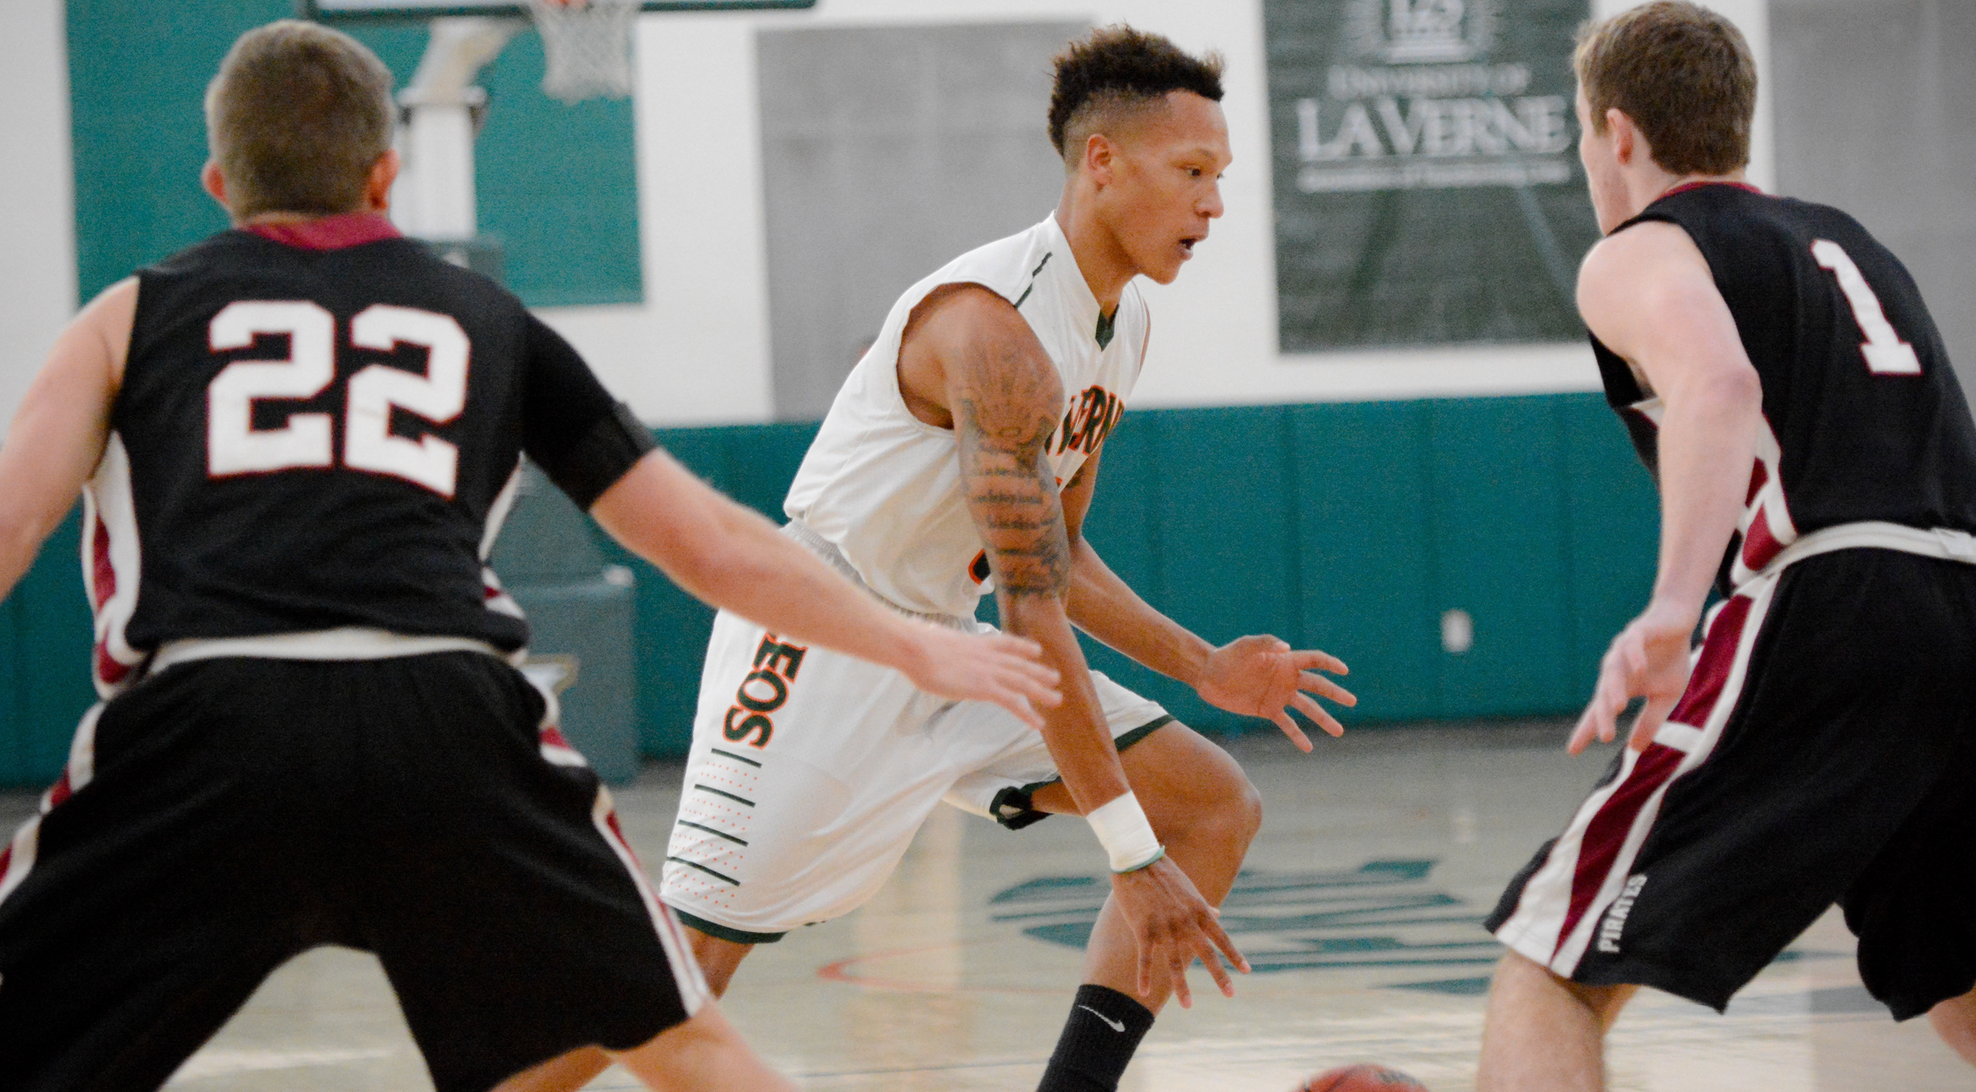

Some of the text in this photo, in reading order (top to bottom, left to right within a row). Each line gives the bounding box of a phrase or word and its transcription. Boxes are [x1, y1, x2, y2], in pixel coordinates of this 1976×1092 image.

[1374, 95, 1571, 158] VERNE
[1810, 238, 1923, 375] 1
[206, 299, 471, 500] 22
[1056, 384, 1126, 456] VERN
[722, 630, 809, 749] EOS
[1597, 872, 1648, 953] PIRATES
